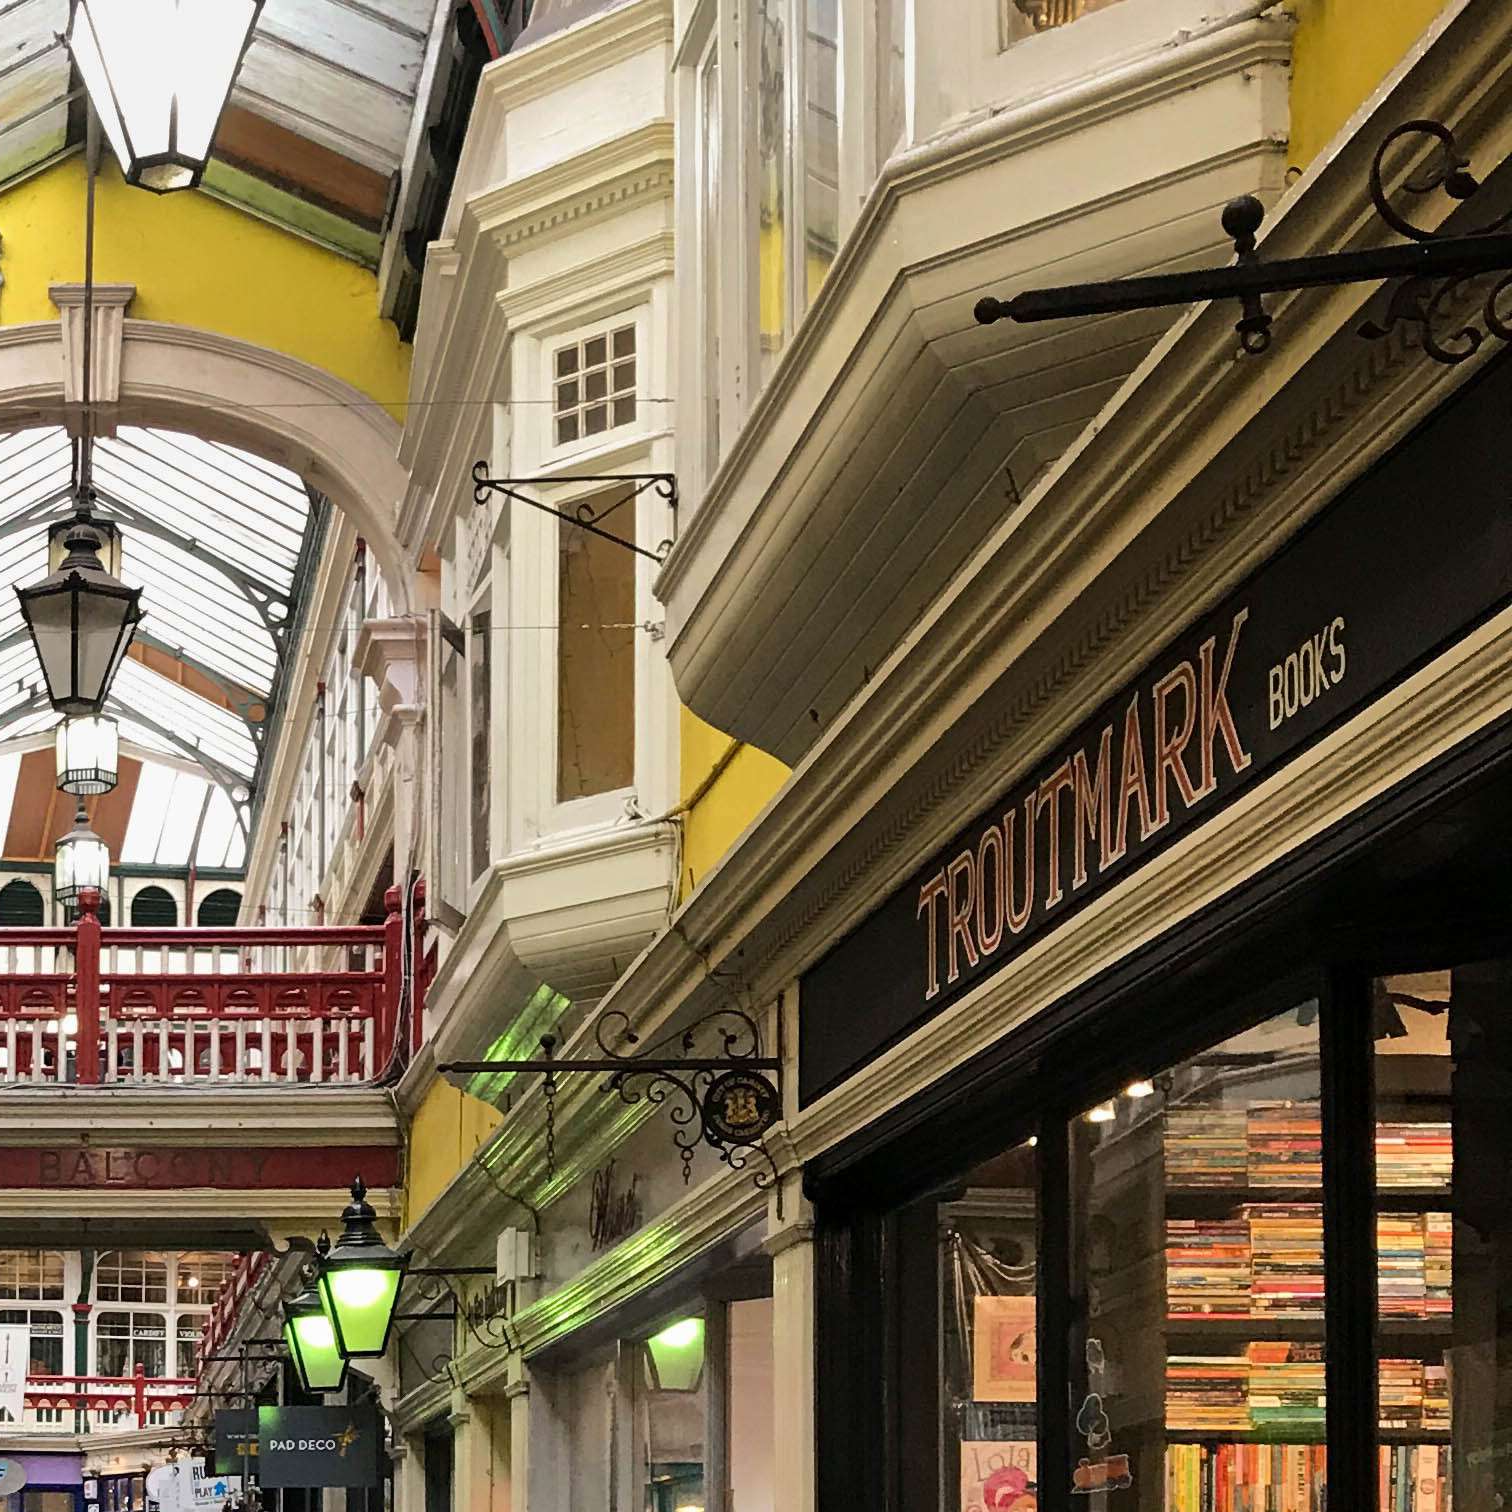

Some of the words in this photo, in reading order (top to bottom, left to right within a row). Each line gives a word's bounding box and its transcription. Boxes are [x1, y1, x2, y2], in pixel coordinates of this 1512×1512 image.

[917, 607, 1252, 1001] TROUTMARK
[1268, 616, 1346, 731] BOOKS
[39, 1150, 270, 1184] BALCONY
[133, 1328, 166, 1338] CARDIFF
[269, 1439, 296, 1452] PAD
[299, 1439, 336, 1452] DECO
[194, 1486, 213, 1500] PLAY
